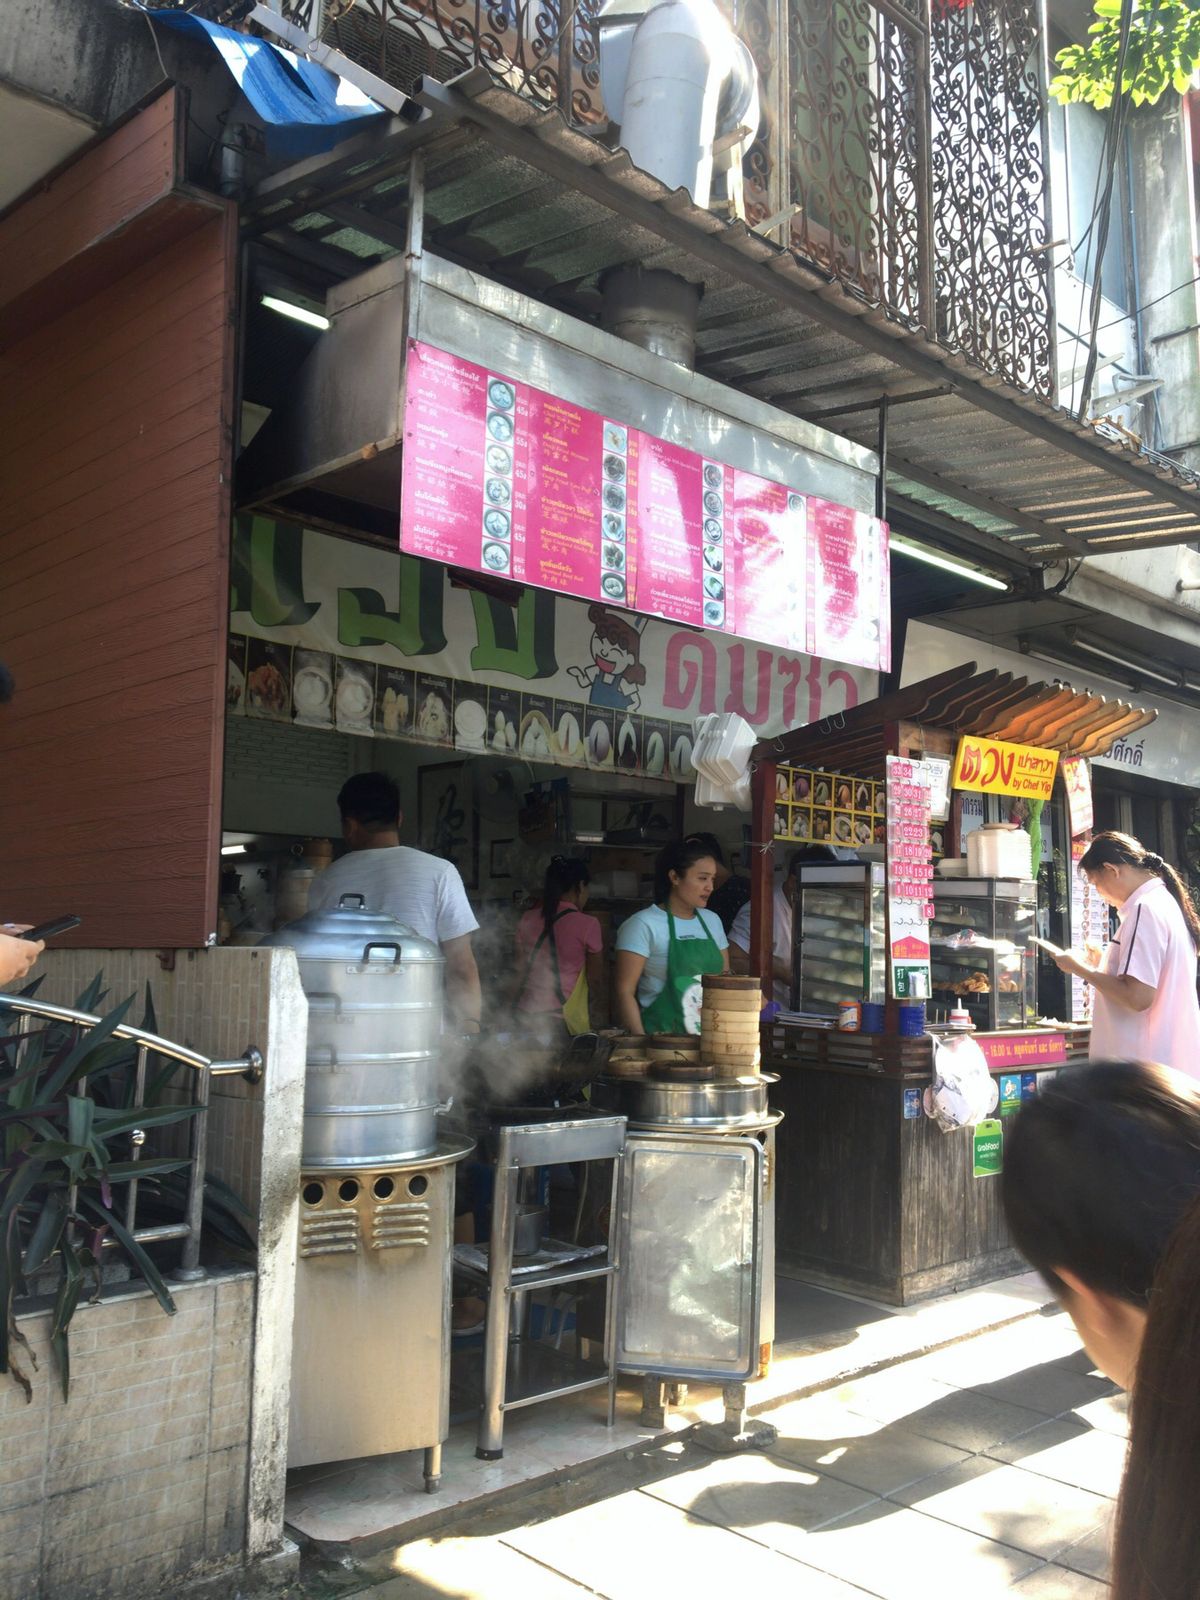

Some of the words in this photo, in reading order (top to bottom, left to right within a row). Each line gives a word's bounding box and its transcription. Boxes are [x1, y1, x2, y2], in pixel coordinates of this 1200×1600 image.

[903, 767, 912, 778] 34
[1012, 777, 1021, 790] by
[1022, 779, 1040, 791] Chef
[1040, 781, 1052, 794] Yip
[904, 828, 913, 836] 22
[905, 847, 912, 856] 18
[895, 865, 902, 875] 13
[914, 867, 923, 876] 15
[905, 887, 913, 895] 10
[914, 888, 922, 896] 11
[925, 888, 933, 897] 12
[977, 1141, 999, 1152] GrabFood
